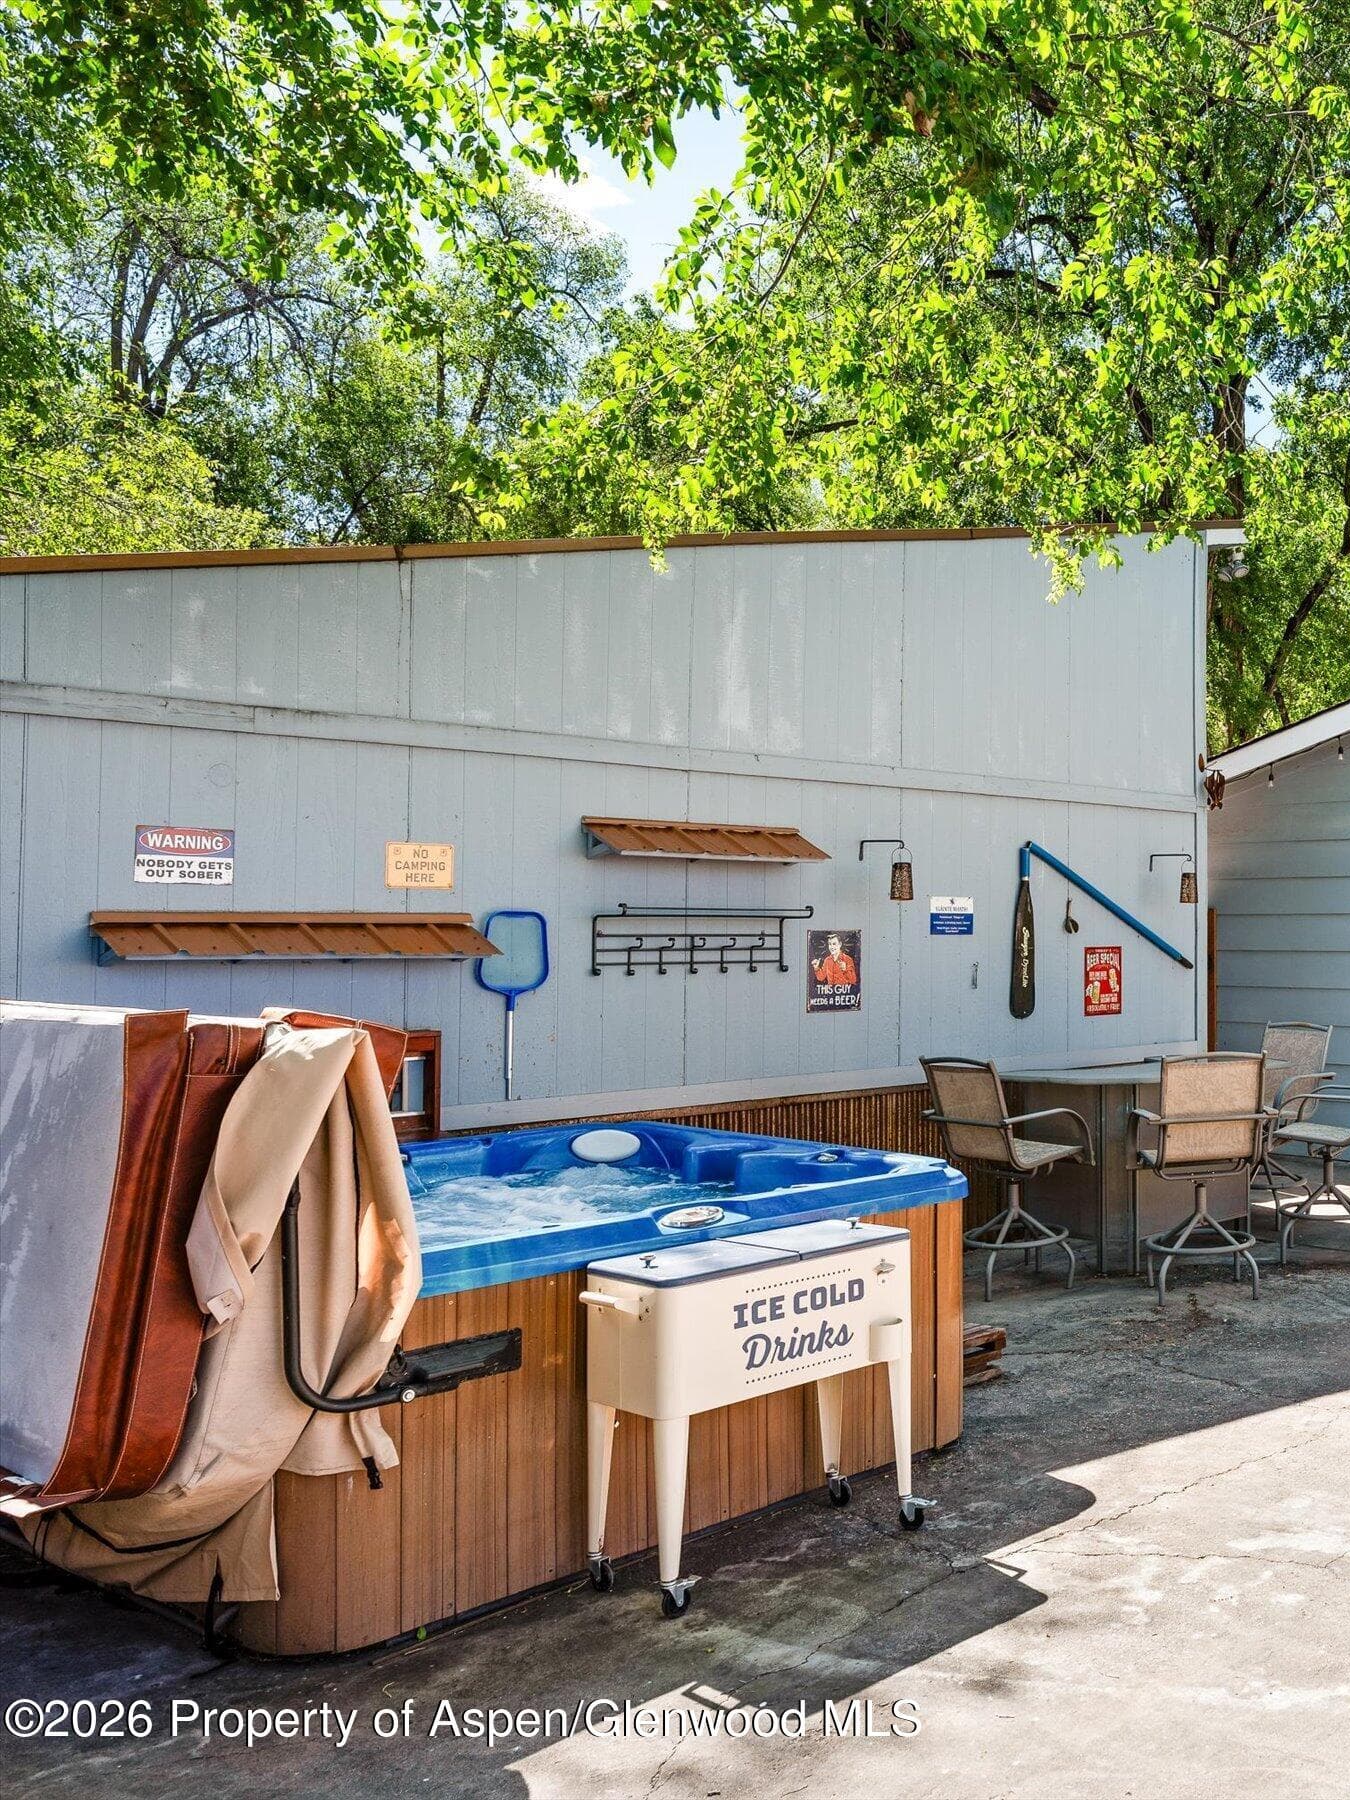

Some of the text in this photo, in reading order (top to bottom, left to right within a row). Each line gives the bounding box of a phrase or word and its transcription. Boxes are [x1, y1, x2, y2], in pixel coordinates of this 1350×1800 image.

[147, 832, 224, 850] WARNING
[413, 849, 429, 859] NO
[136, 859, 232, 870] NOBODY GETS
[395, 860, 446, 871] CAMPING
[145, 869, 223, 880] OUT SOBER
[405, 872, 435, 883] HERE
[816, 984, 852, 995] THIS GUY
[829, 997, 833, 1005] A
[834, 993, 860, 1007] BEER!
[733, 1278, 865, 1329] ICE COLD
[742, 1320, 854, 1371] Drinks
